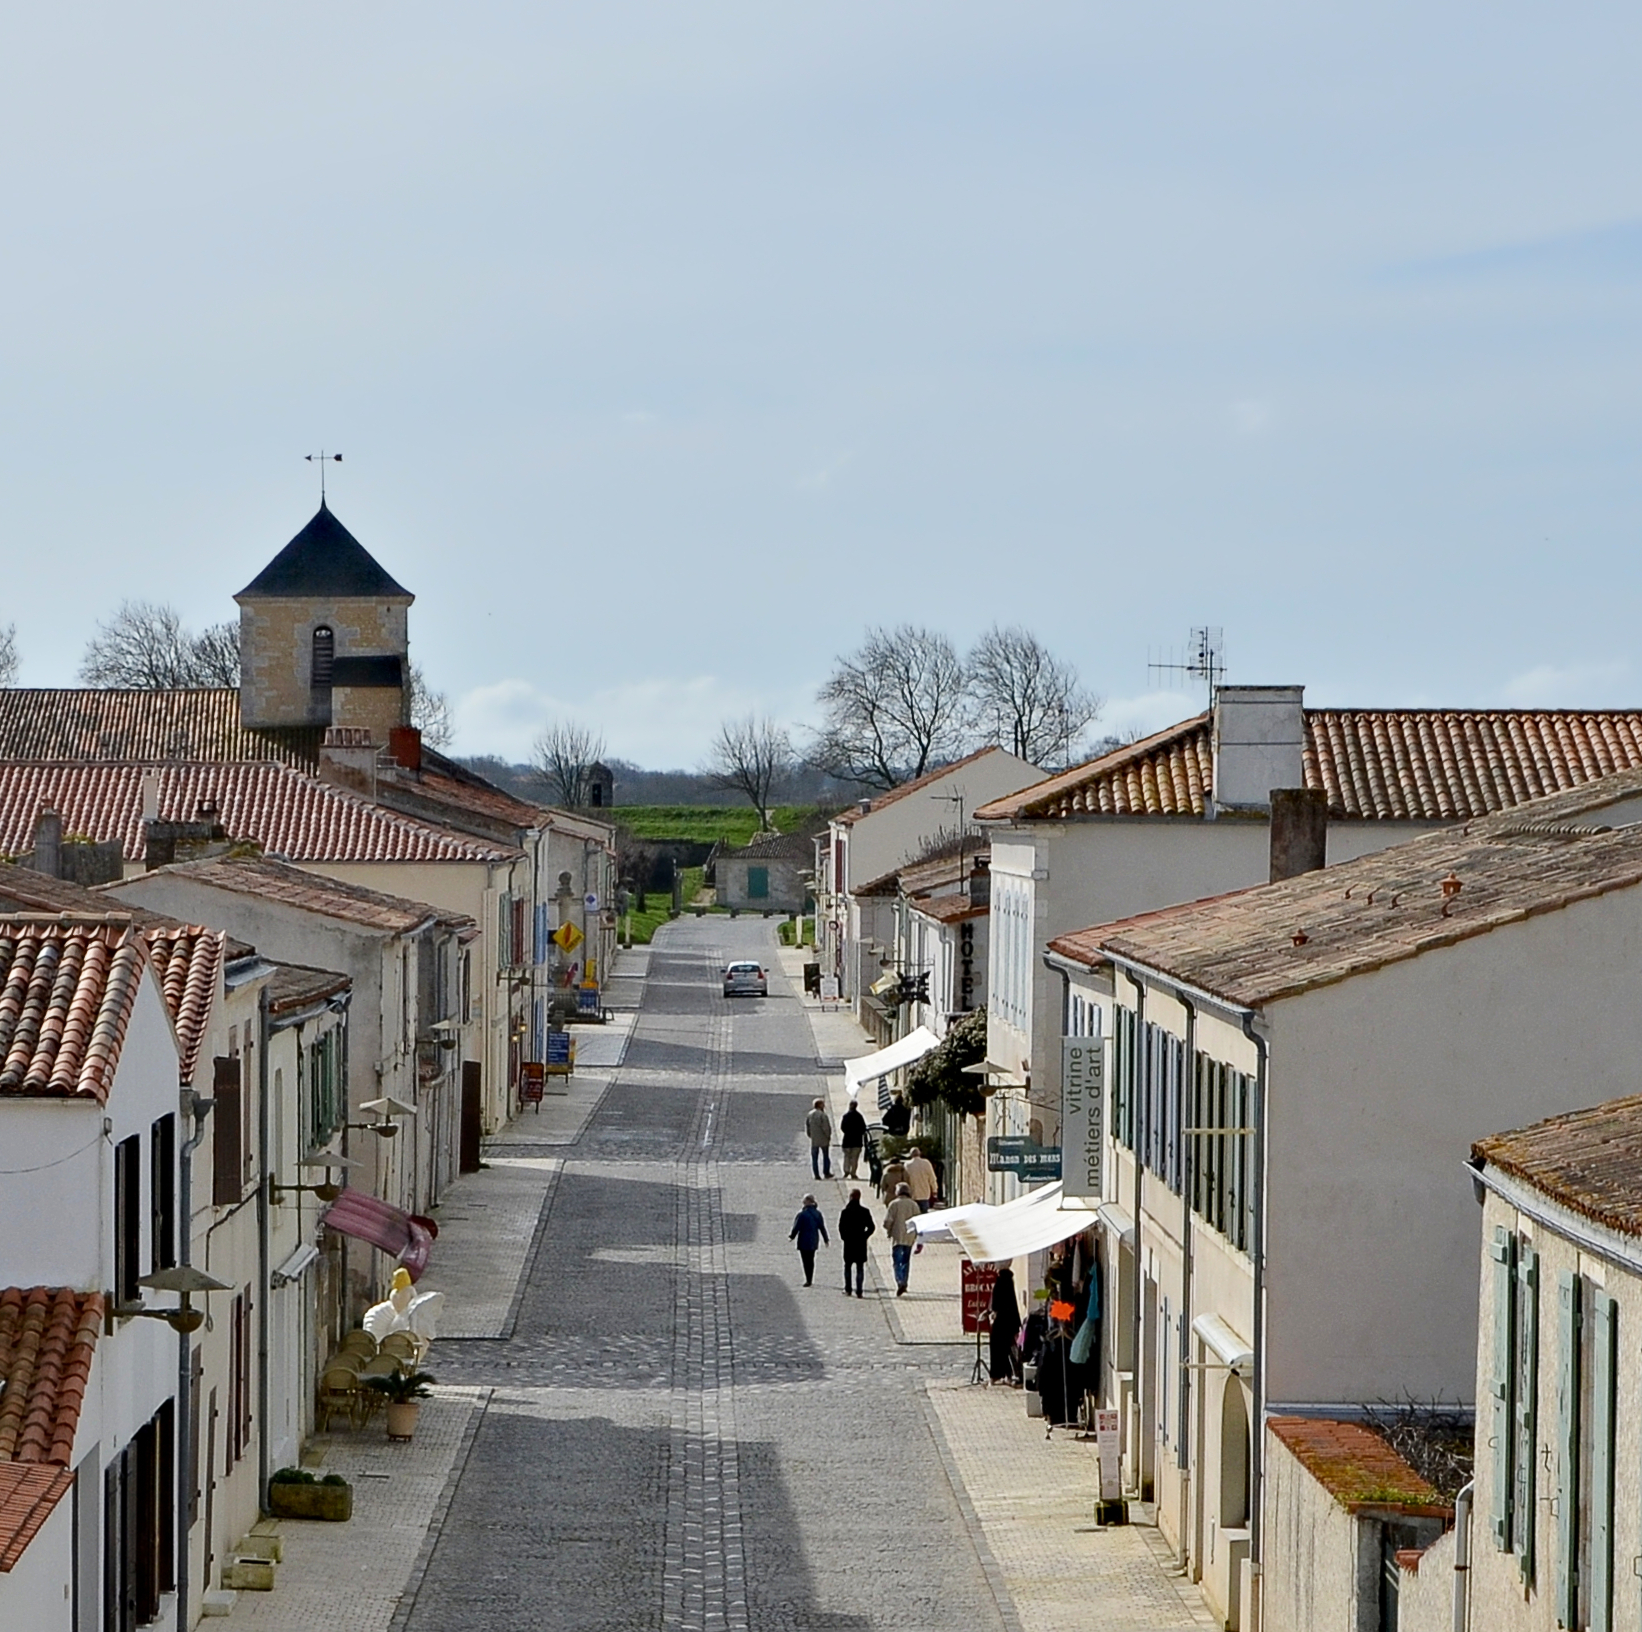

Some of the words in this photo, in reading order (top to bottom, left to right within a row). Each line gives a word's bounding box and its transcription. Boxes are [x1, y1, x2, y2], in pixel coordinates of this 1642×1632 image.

[961, 923, 973, 1012] HOTEL
[1066, 1047, 1082, 1114] vitrine
[1085, 1047, 1101, 1099] d'art
[1084, 1108, 1100, 1187] métiers
